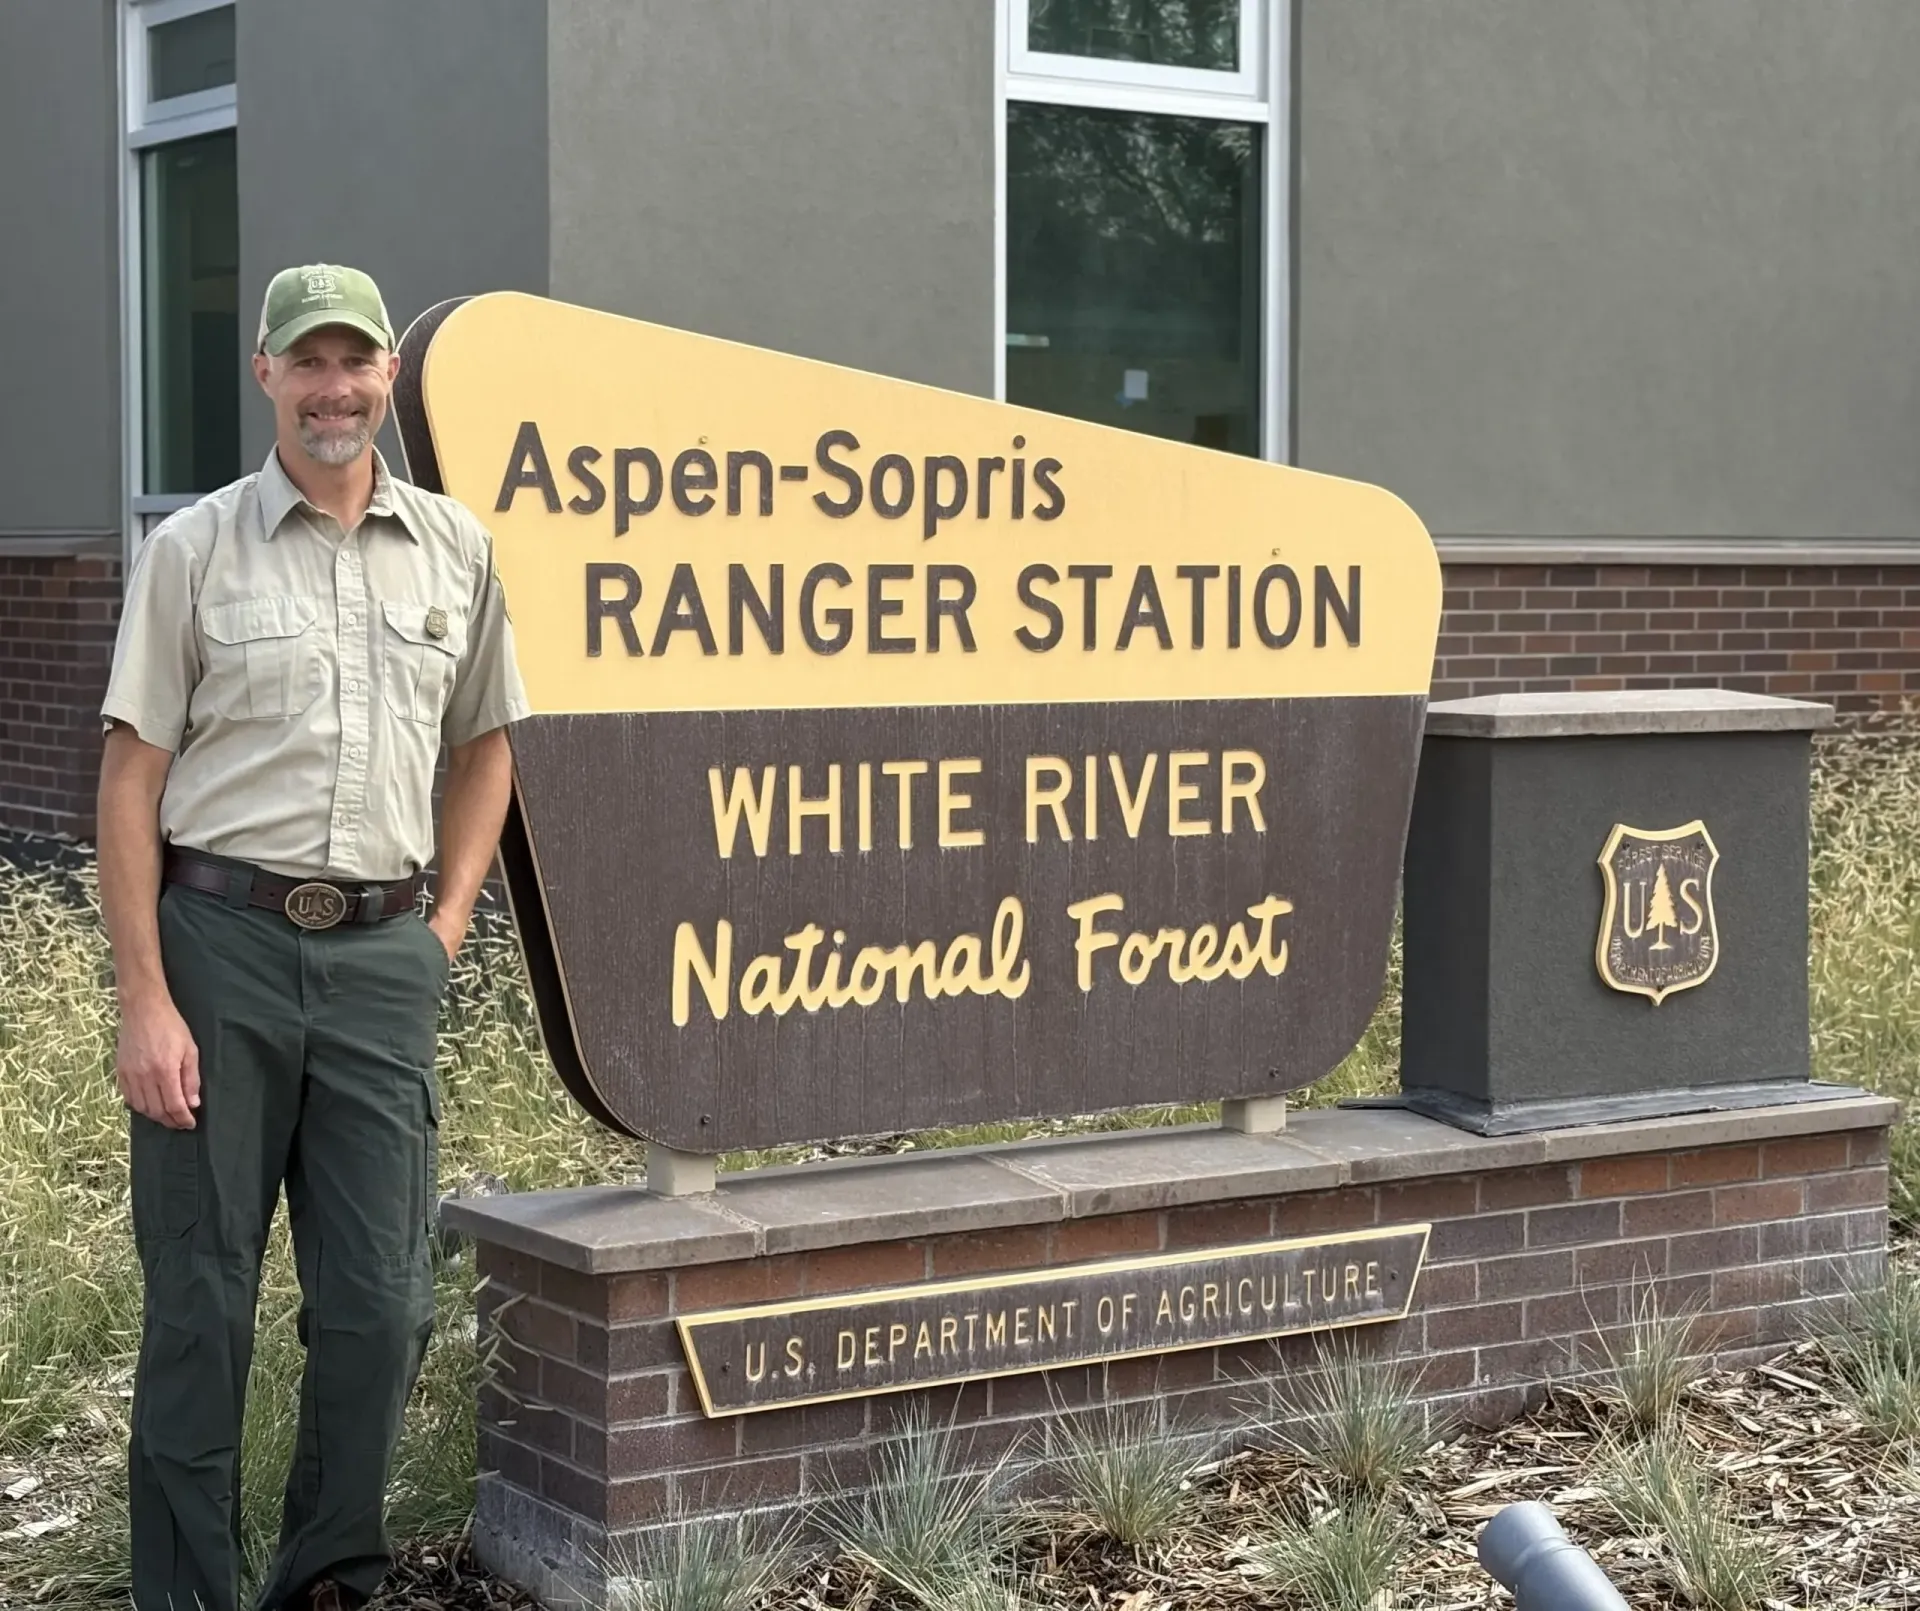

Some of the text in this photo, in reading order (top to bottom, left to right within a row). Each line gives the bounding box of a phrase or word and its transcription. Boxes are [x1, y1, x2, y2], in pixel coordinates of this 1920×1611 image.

[494, 421, 1066, 541] Aspen-Sopris
[584, 562, 1361, 657] RANGER STATION
[708, 750, 1267, 858] WHITE RIVER
[672, 894, 1293, 1026] National Forest
[745, 1261, 1380, 1381] U.S. DEPARTMENT OF AGRICULTURE
